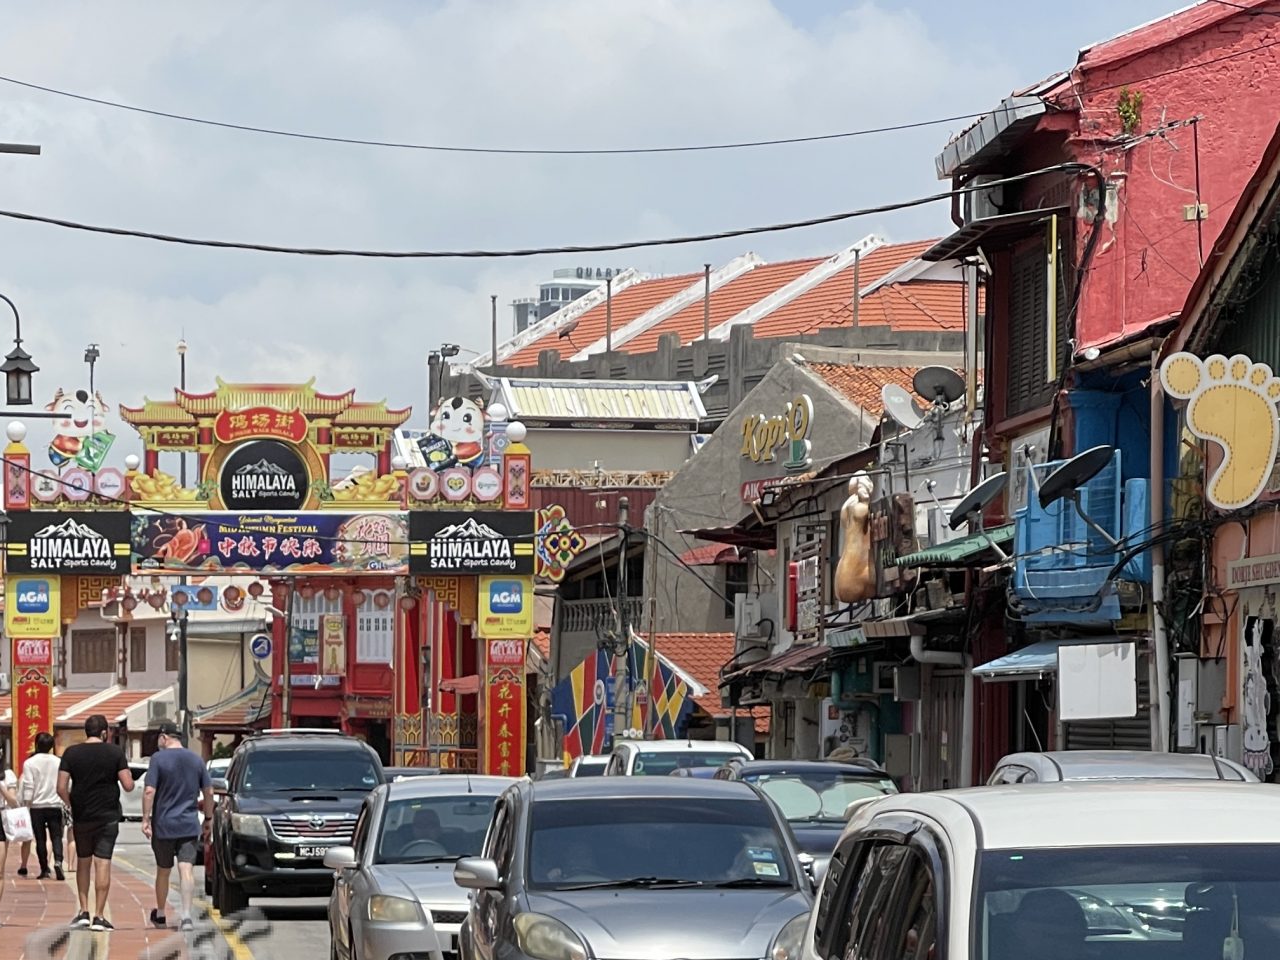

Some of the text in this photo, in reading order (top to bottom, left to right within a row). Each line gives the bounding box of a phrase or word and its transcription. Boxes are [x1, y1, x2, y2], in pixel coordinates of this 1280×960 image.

[576, 267, 629, 279] QUART
[231, 474, 296, 490] HIMALAYA
[232, 490, 300, 499] SALT Sports Candy
[743, 482, 760, 499] AIK
[277, 525, 318, 533] FESTIVAL
[30, 538, 112, 558] HIMALAYA
[218, 535, 322, 560] 中秋节快乐
[430, 538, 512, 558] HIMALAYA
[30, 558, 117, 569] SALT Sports Candy
[430, 558, 516, 569] SALT Sports Candy
[19, 590, 48, 603] AGM
[492, 590, 521, 603] AGM
